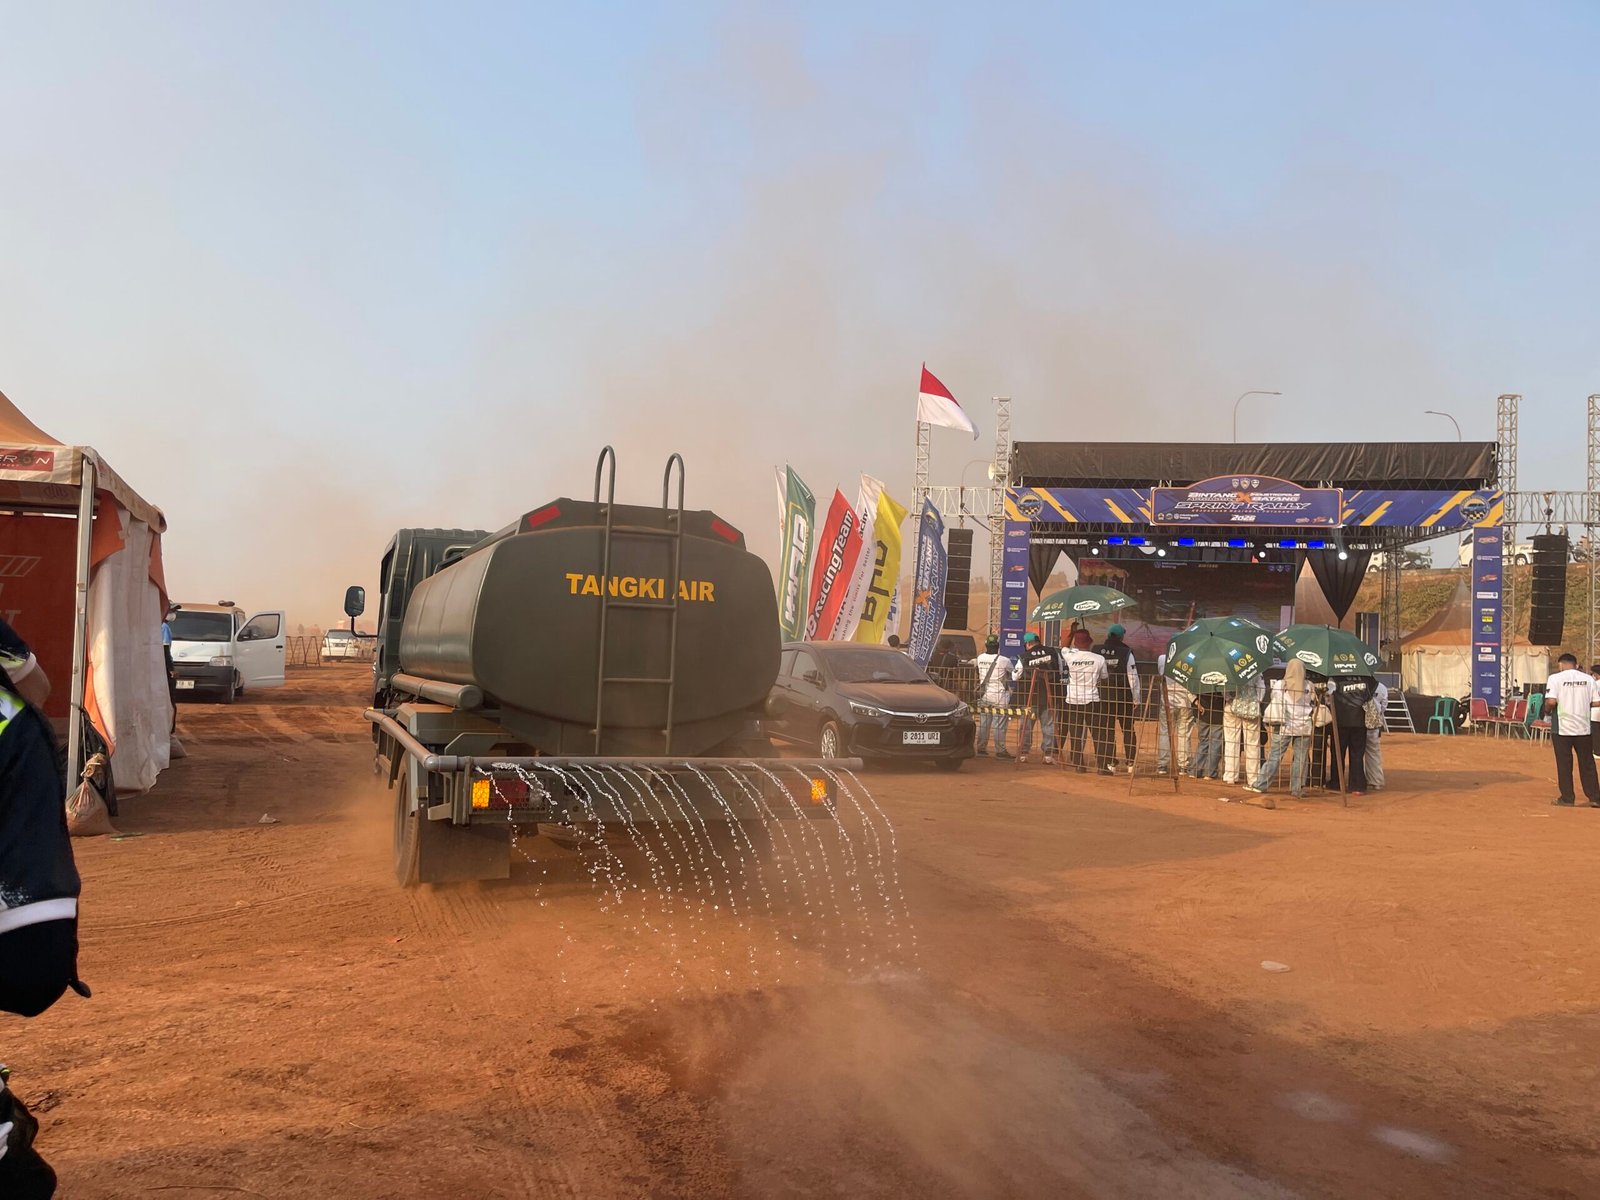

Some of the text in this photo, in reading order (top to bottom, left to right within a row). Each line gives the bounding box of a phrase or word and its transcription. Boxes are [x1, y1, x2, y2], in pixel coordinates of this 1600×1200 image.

[1174, 501, 1312, 511] SPRINT RALLY
[566, 572, 715, 602] TANGKI AIR
[921, 535, 933, 591] BATANG
[908, 604, 922, 660] BINTANG
[920, 600, 937, 660] SPRINT
